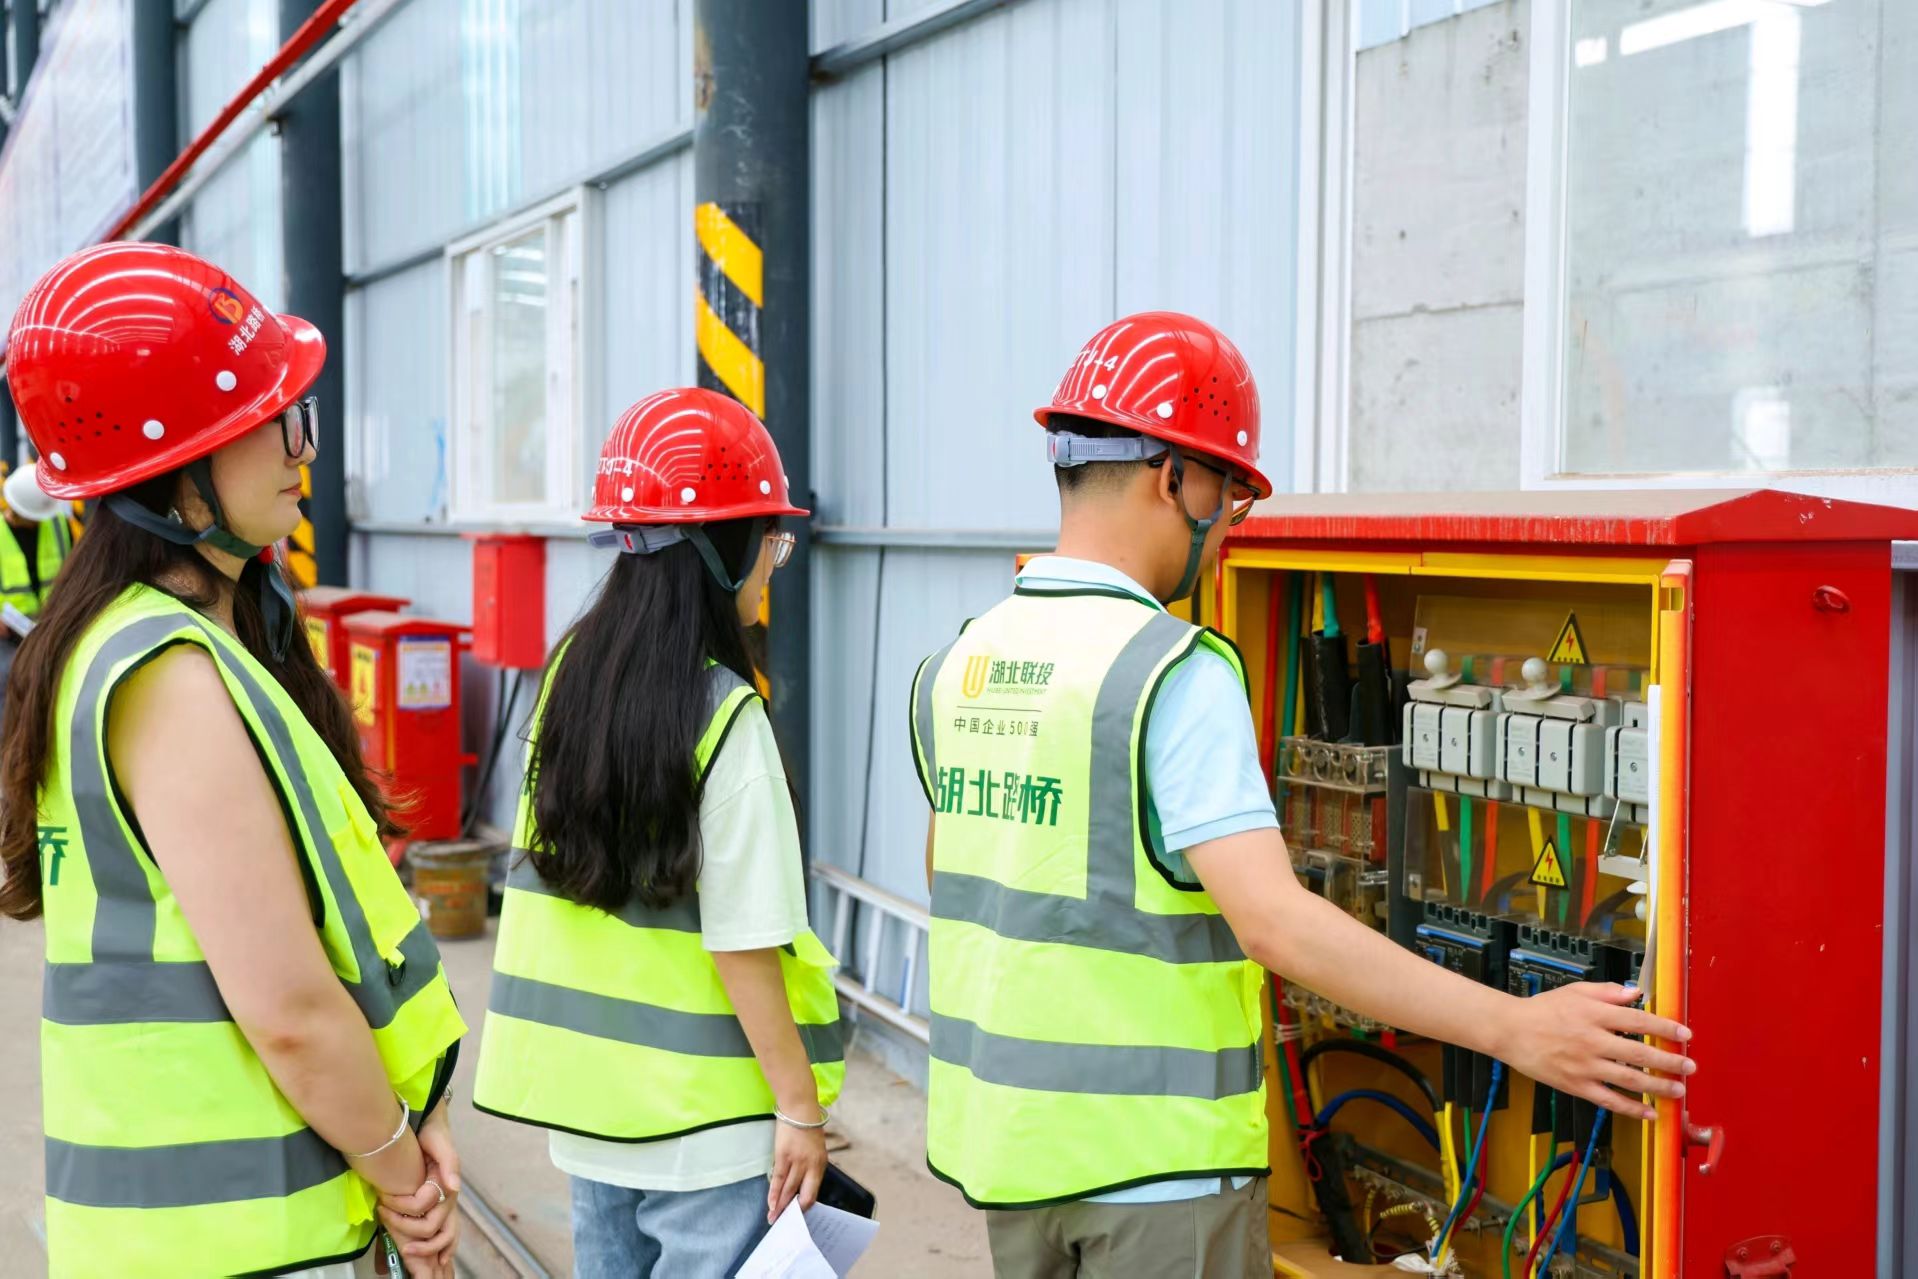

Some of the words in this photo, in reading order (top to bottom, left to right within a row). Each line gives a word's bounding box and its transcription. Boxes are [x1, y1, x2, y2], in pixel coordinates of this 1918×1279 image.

[227, 304, 265, 356] 湖北路桥
[988, 660, 1055, 685] 湖北联投
